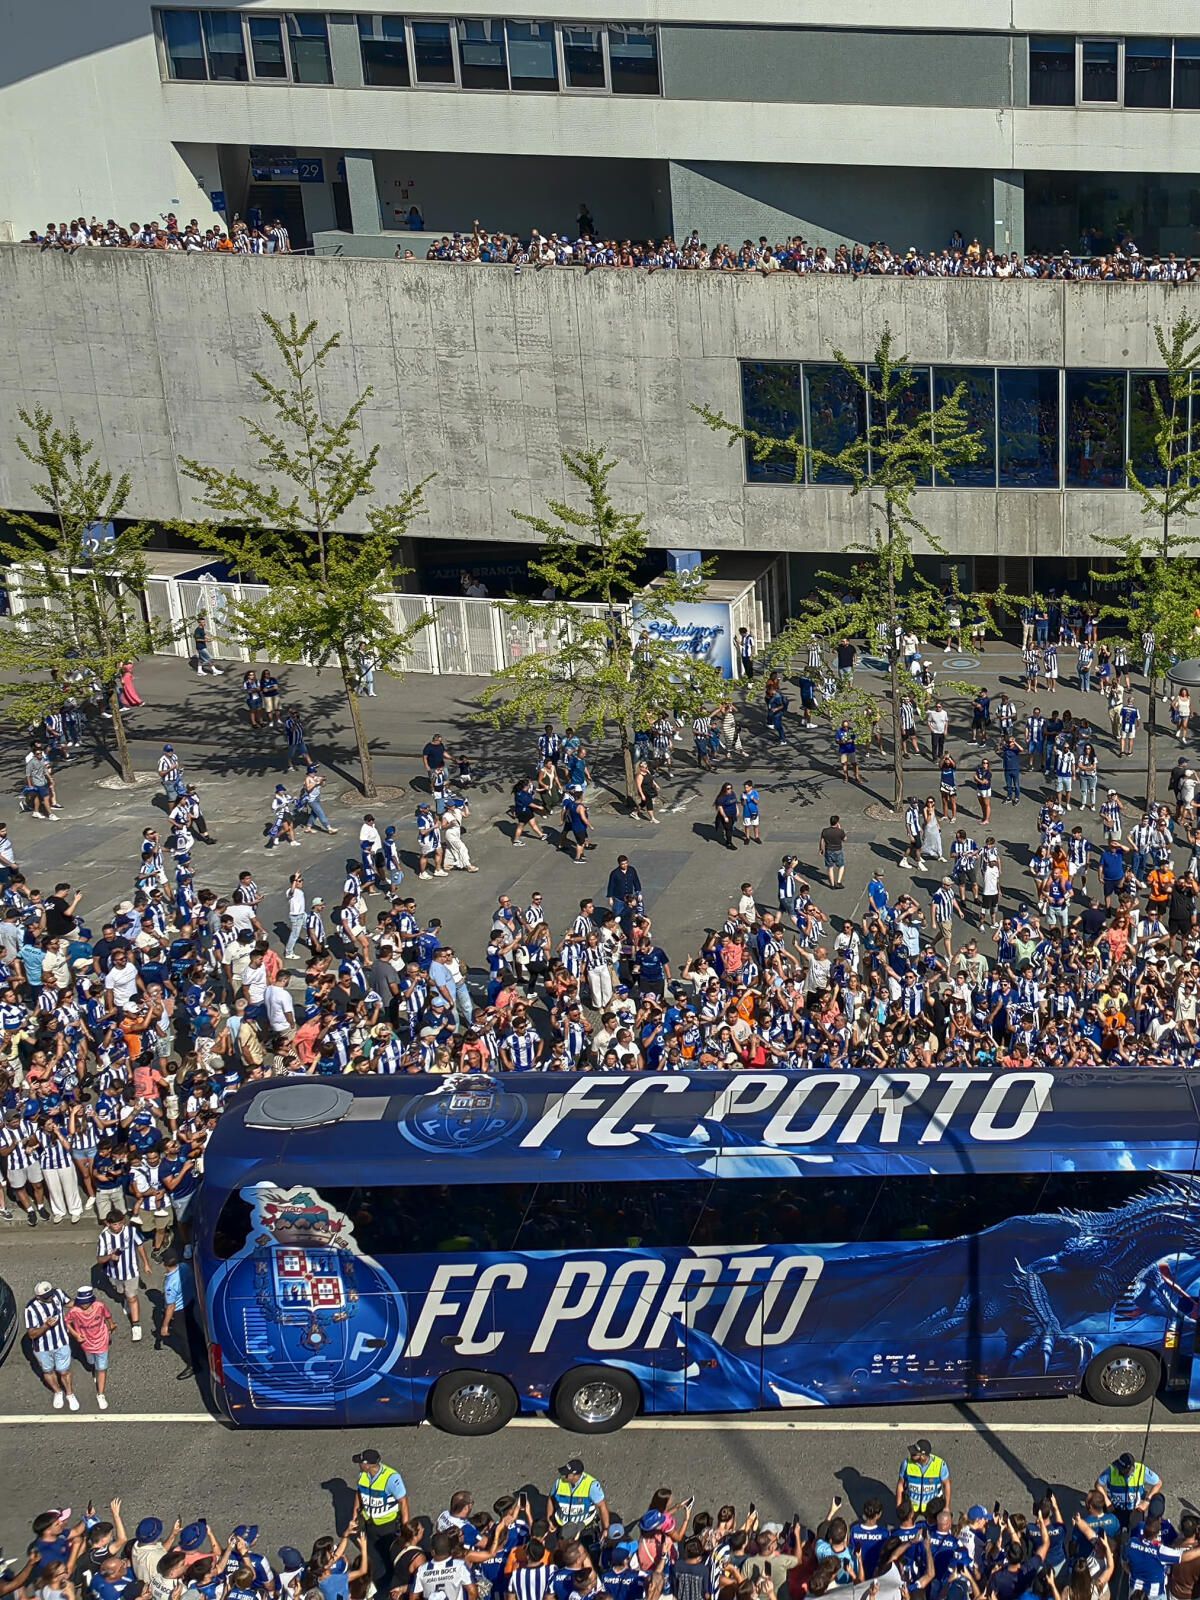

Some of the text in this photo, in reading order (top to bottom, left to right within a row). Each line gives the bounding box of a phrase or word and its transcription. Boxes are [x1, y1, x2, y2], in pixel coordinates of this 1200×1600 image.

[301, 163, 319, 178] 29
[519, 1072, 1054, 1148] FC PORTO
[404, 1255, 825, 1358] FC PORTO
[868, 1533, 882, 1541] BOCK
[1130, 1542, 1158, 1555] SUPER BOCK
[441, 1567, 456, 1575] BOCK
